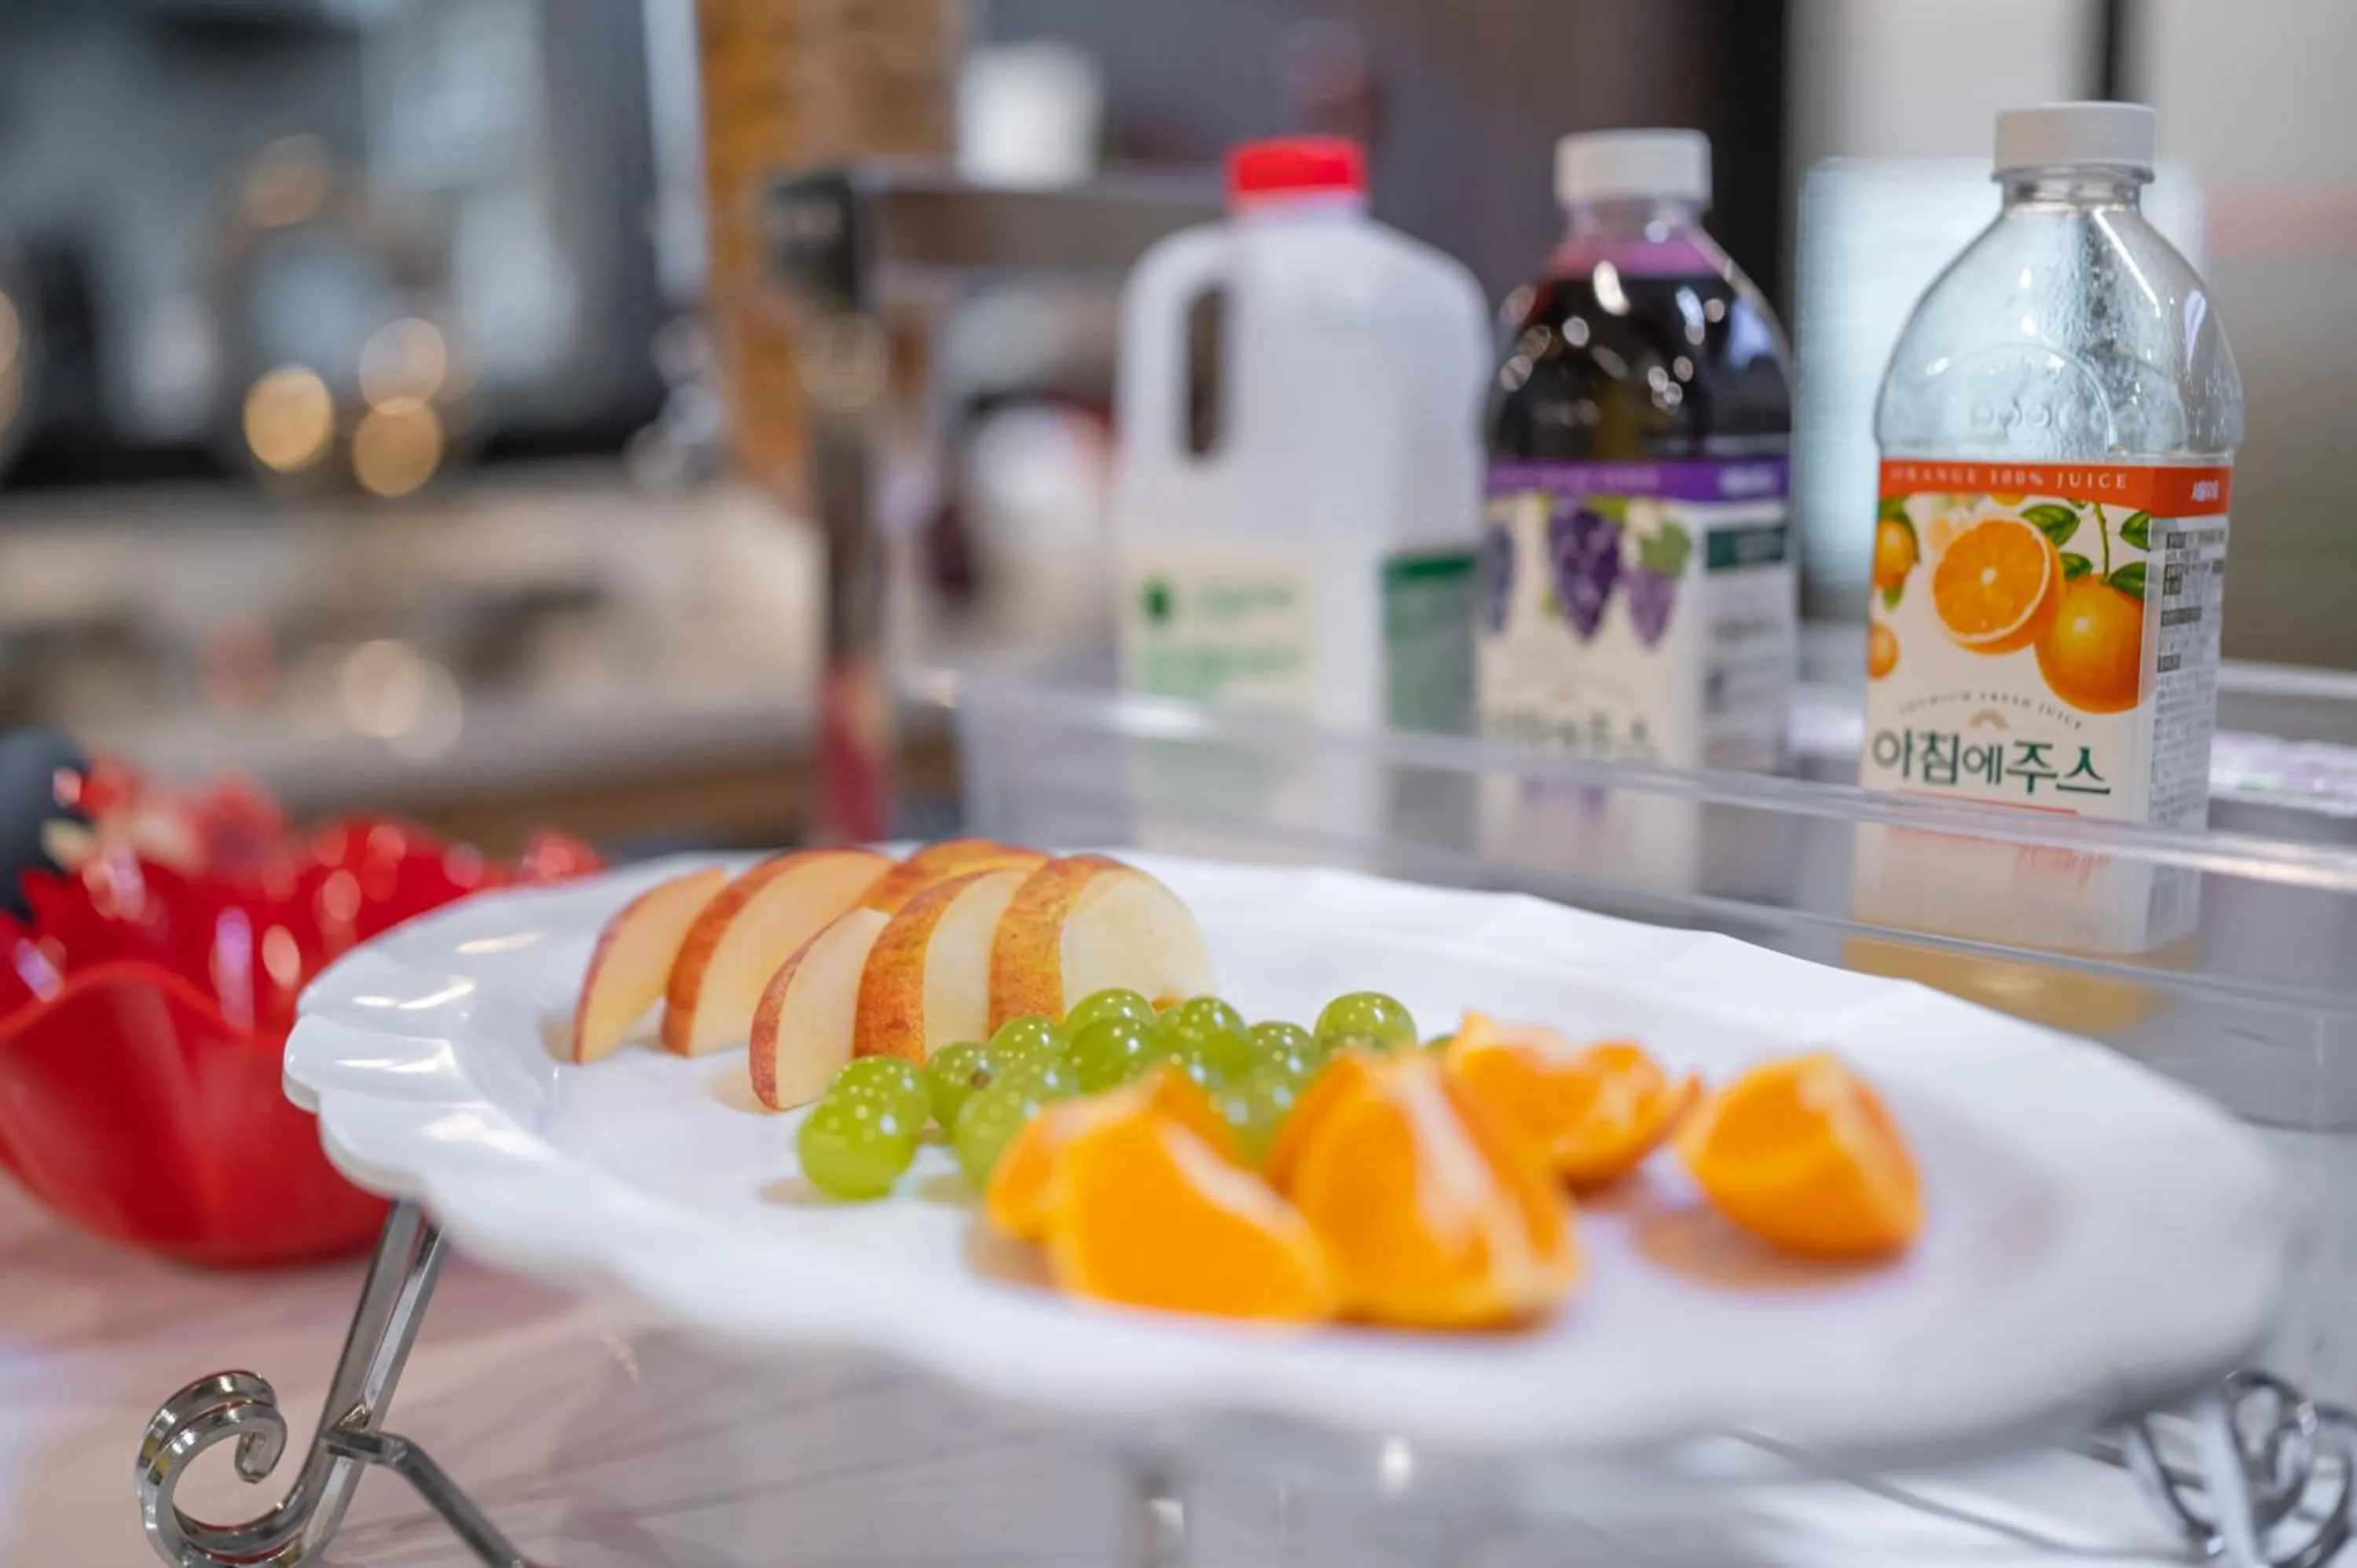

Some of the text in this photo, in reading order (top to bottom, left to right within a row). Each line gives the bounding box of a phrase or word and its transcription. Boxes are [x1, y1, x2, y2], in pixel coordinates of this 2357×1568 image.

[1990, 467, 2044, 487] 100%
[2057, 472, 2127, 489] JUICE
[2037, 702, 2082, 731] JUICE
[1872, 726, 2111, 795] 아침에주스
